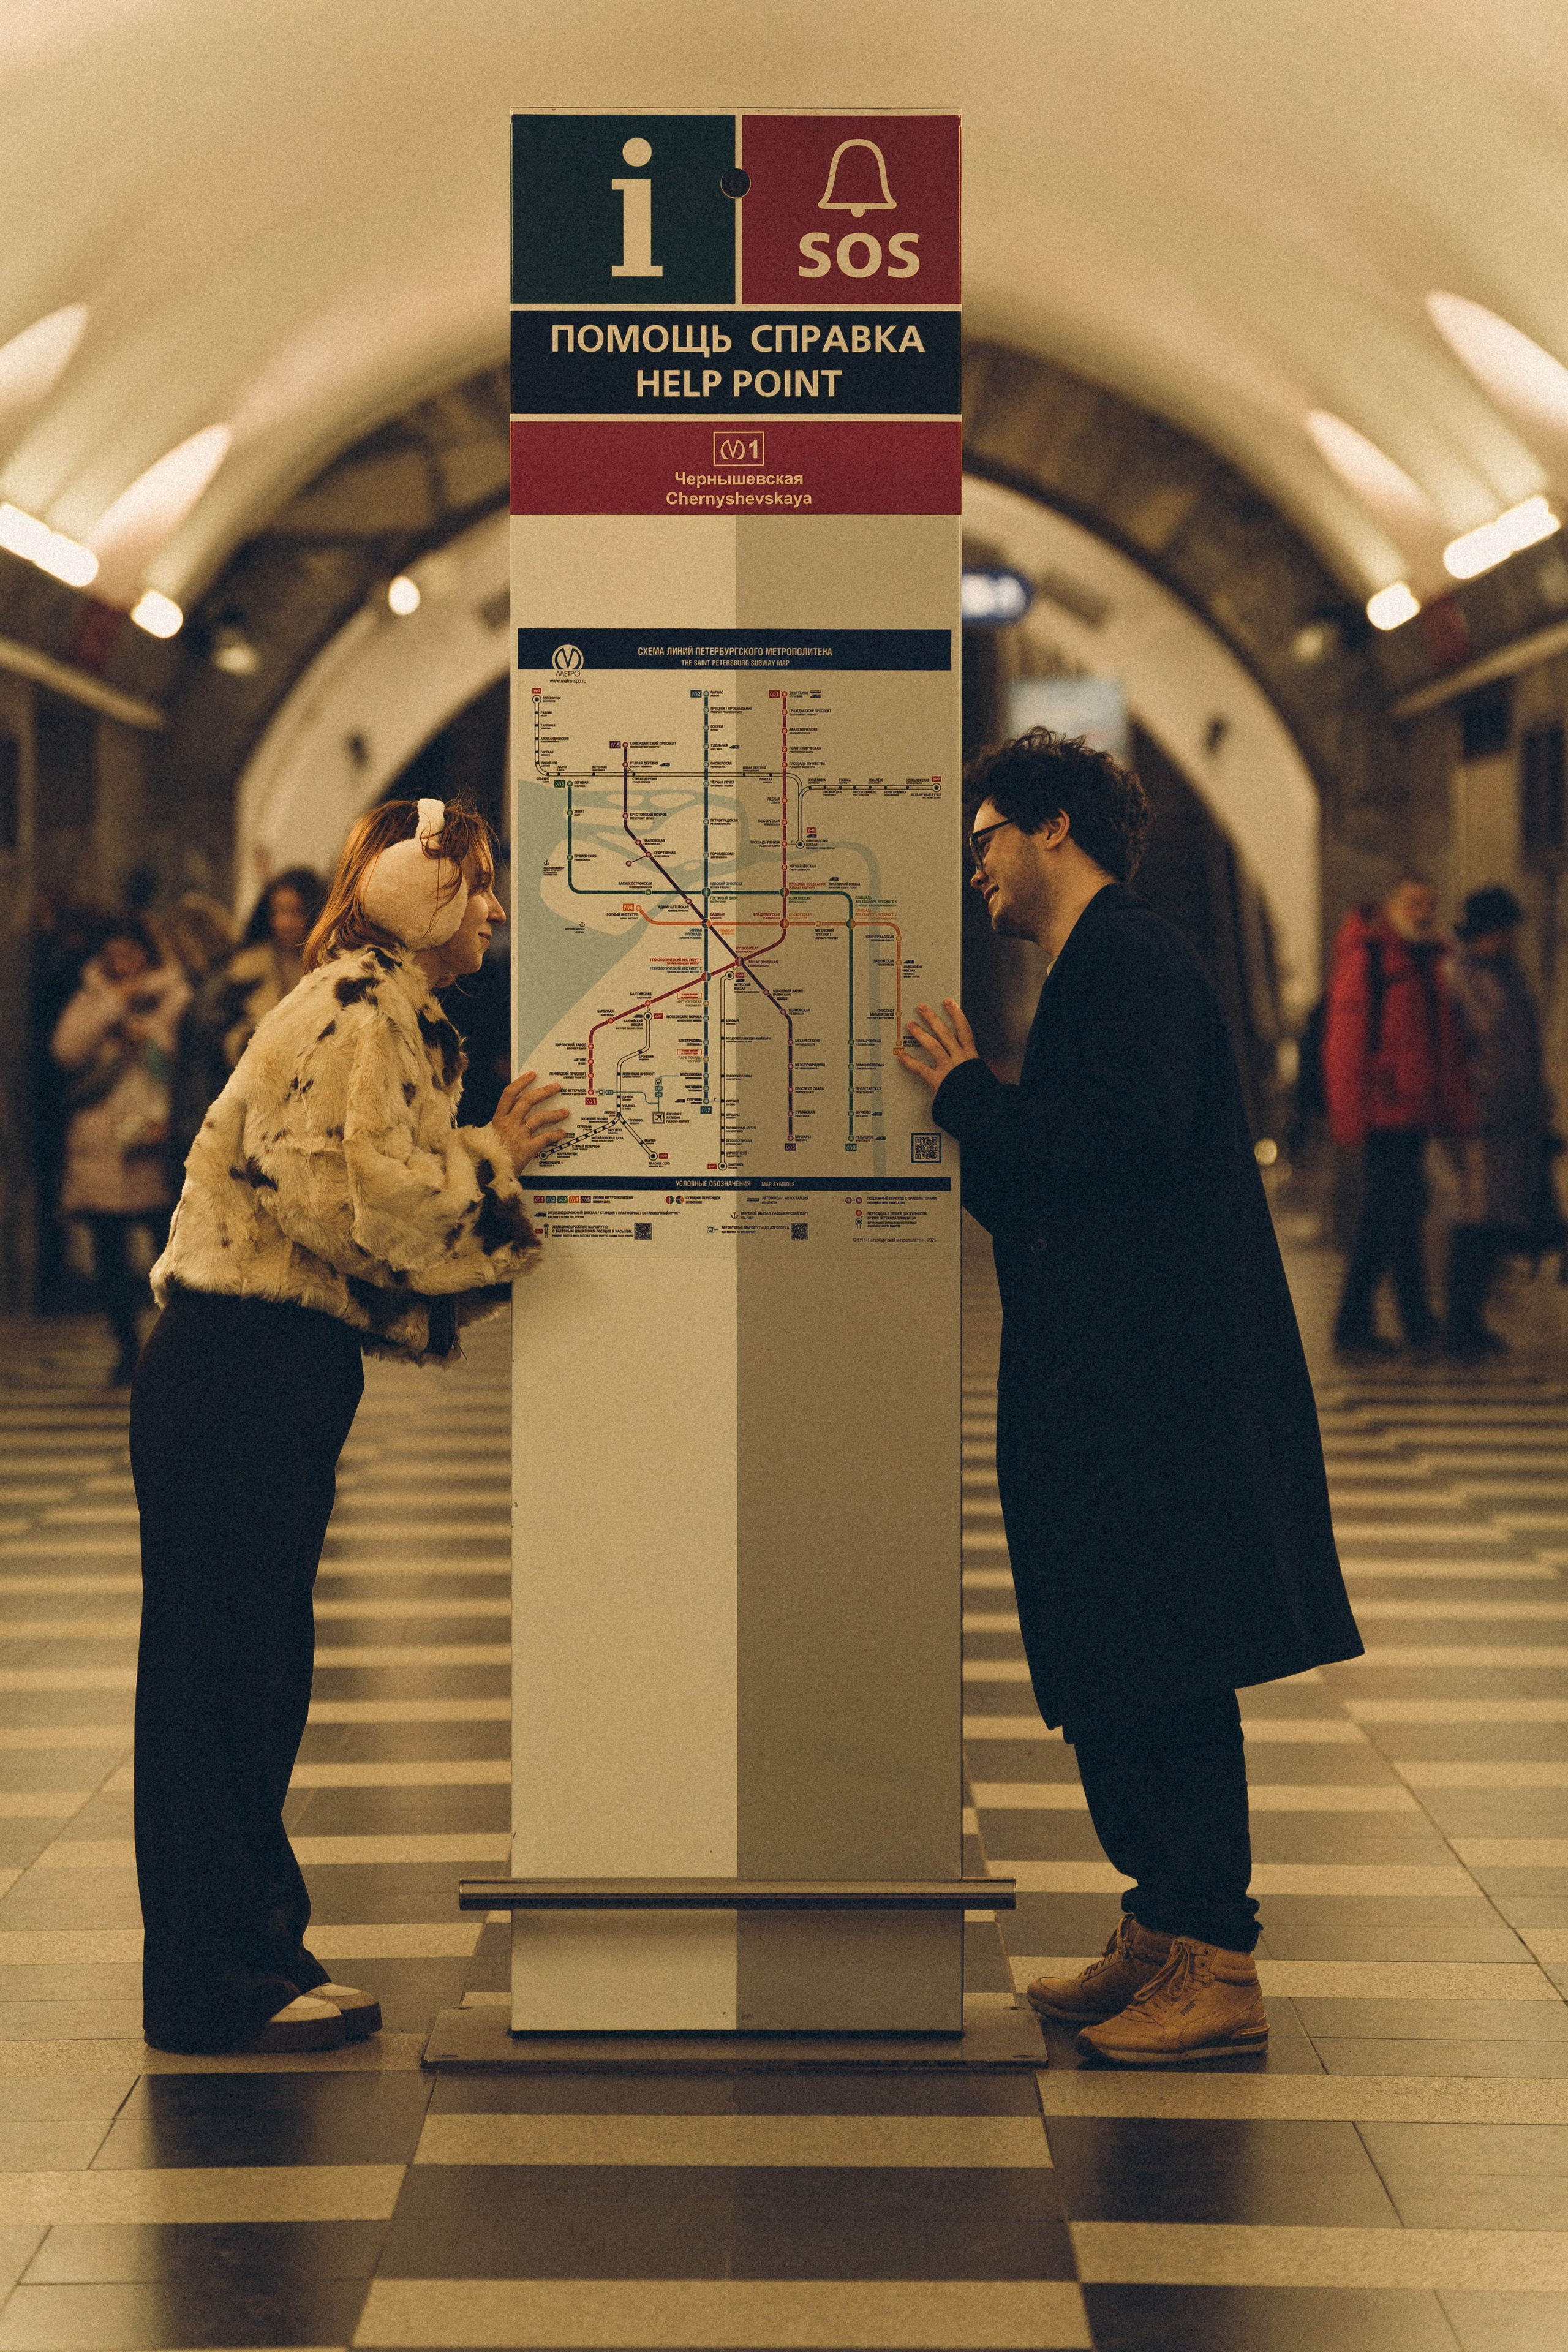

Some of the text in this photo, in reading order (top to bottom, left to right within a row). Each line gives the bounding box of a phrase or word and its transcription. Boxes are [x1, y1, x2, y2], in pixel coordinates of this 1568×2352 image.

[799, 232, 920, 278] SOS
[552, 325, 925, 357] ПОМОЩЬ СПРАВКА
[637, 370, 842, 397] HELP POINT
[674, 472, 804, 488] Чернышевская
[666, 492, 812, 508] Chernyshevskaya
[638, 646, 833, 656] СХЕМА ЛИНИЙ ПЕТЕРБУРГСКОГО МЕТРОПОЛИТЕНА
